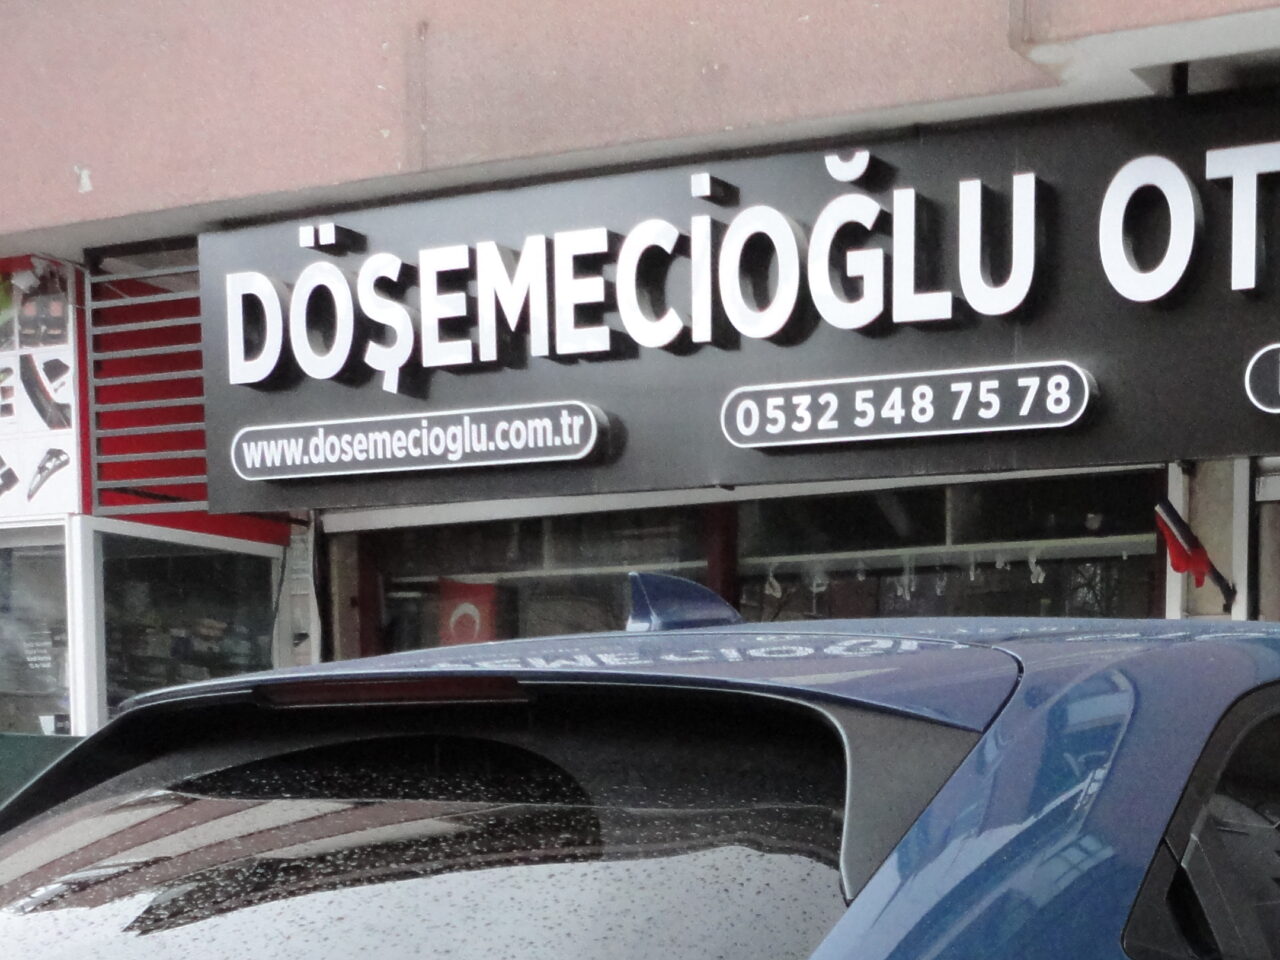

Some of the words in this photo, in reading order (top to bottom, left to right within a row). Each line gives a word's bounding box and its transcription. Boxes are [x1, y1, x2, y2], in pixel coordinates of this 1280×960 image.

[226, 150, 1036, 394] DÖŞEMECİOĞLU
[735, 392, 839, 436] 0532
[853, 384, 935, 428] 548
[950, 379, 1000, 421] 75
[1017, 374, 1071, 417] 78
[241, 409, 585, 469] www.dosemecioglu.com.tr
